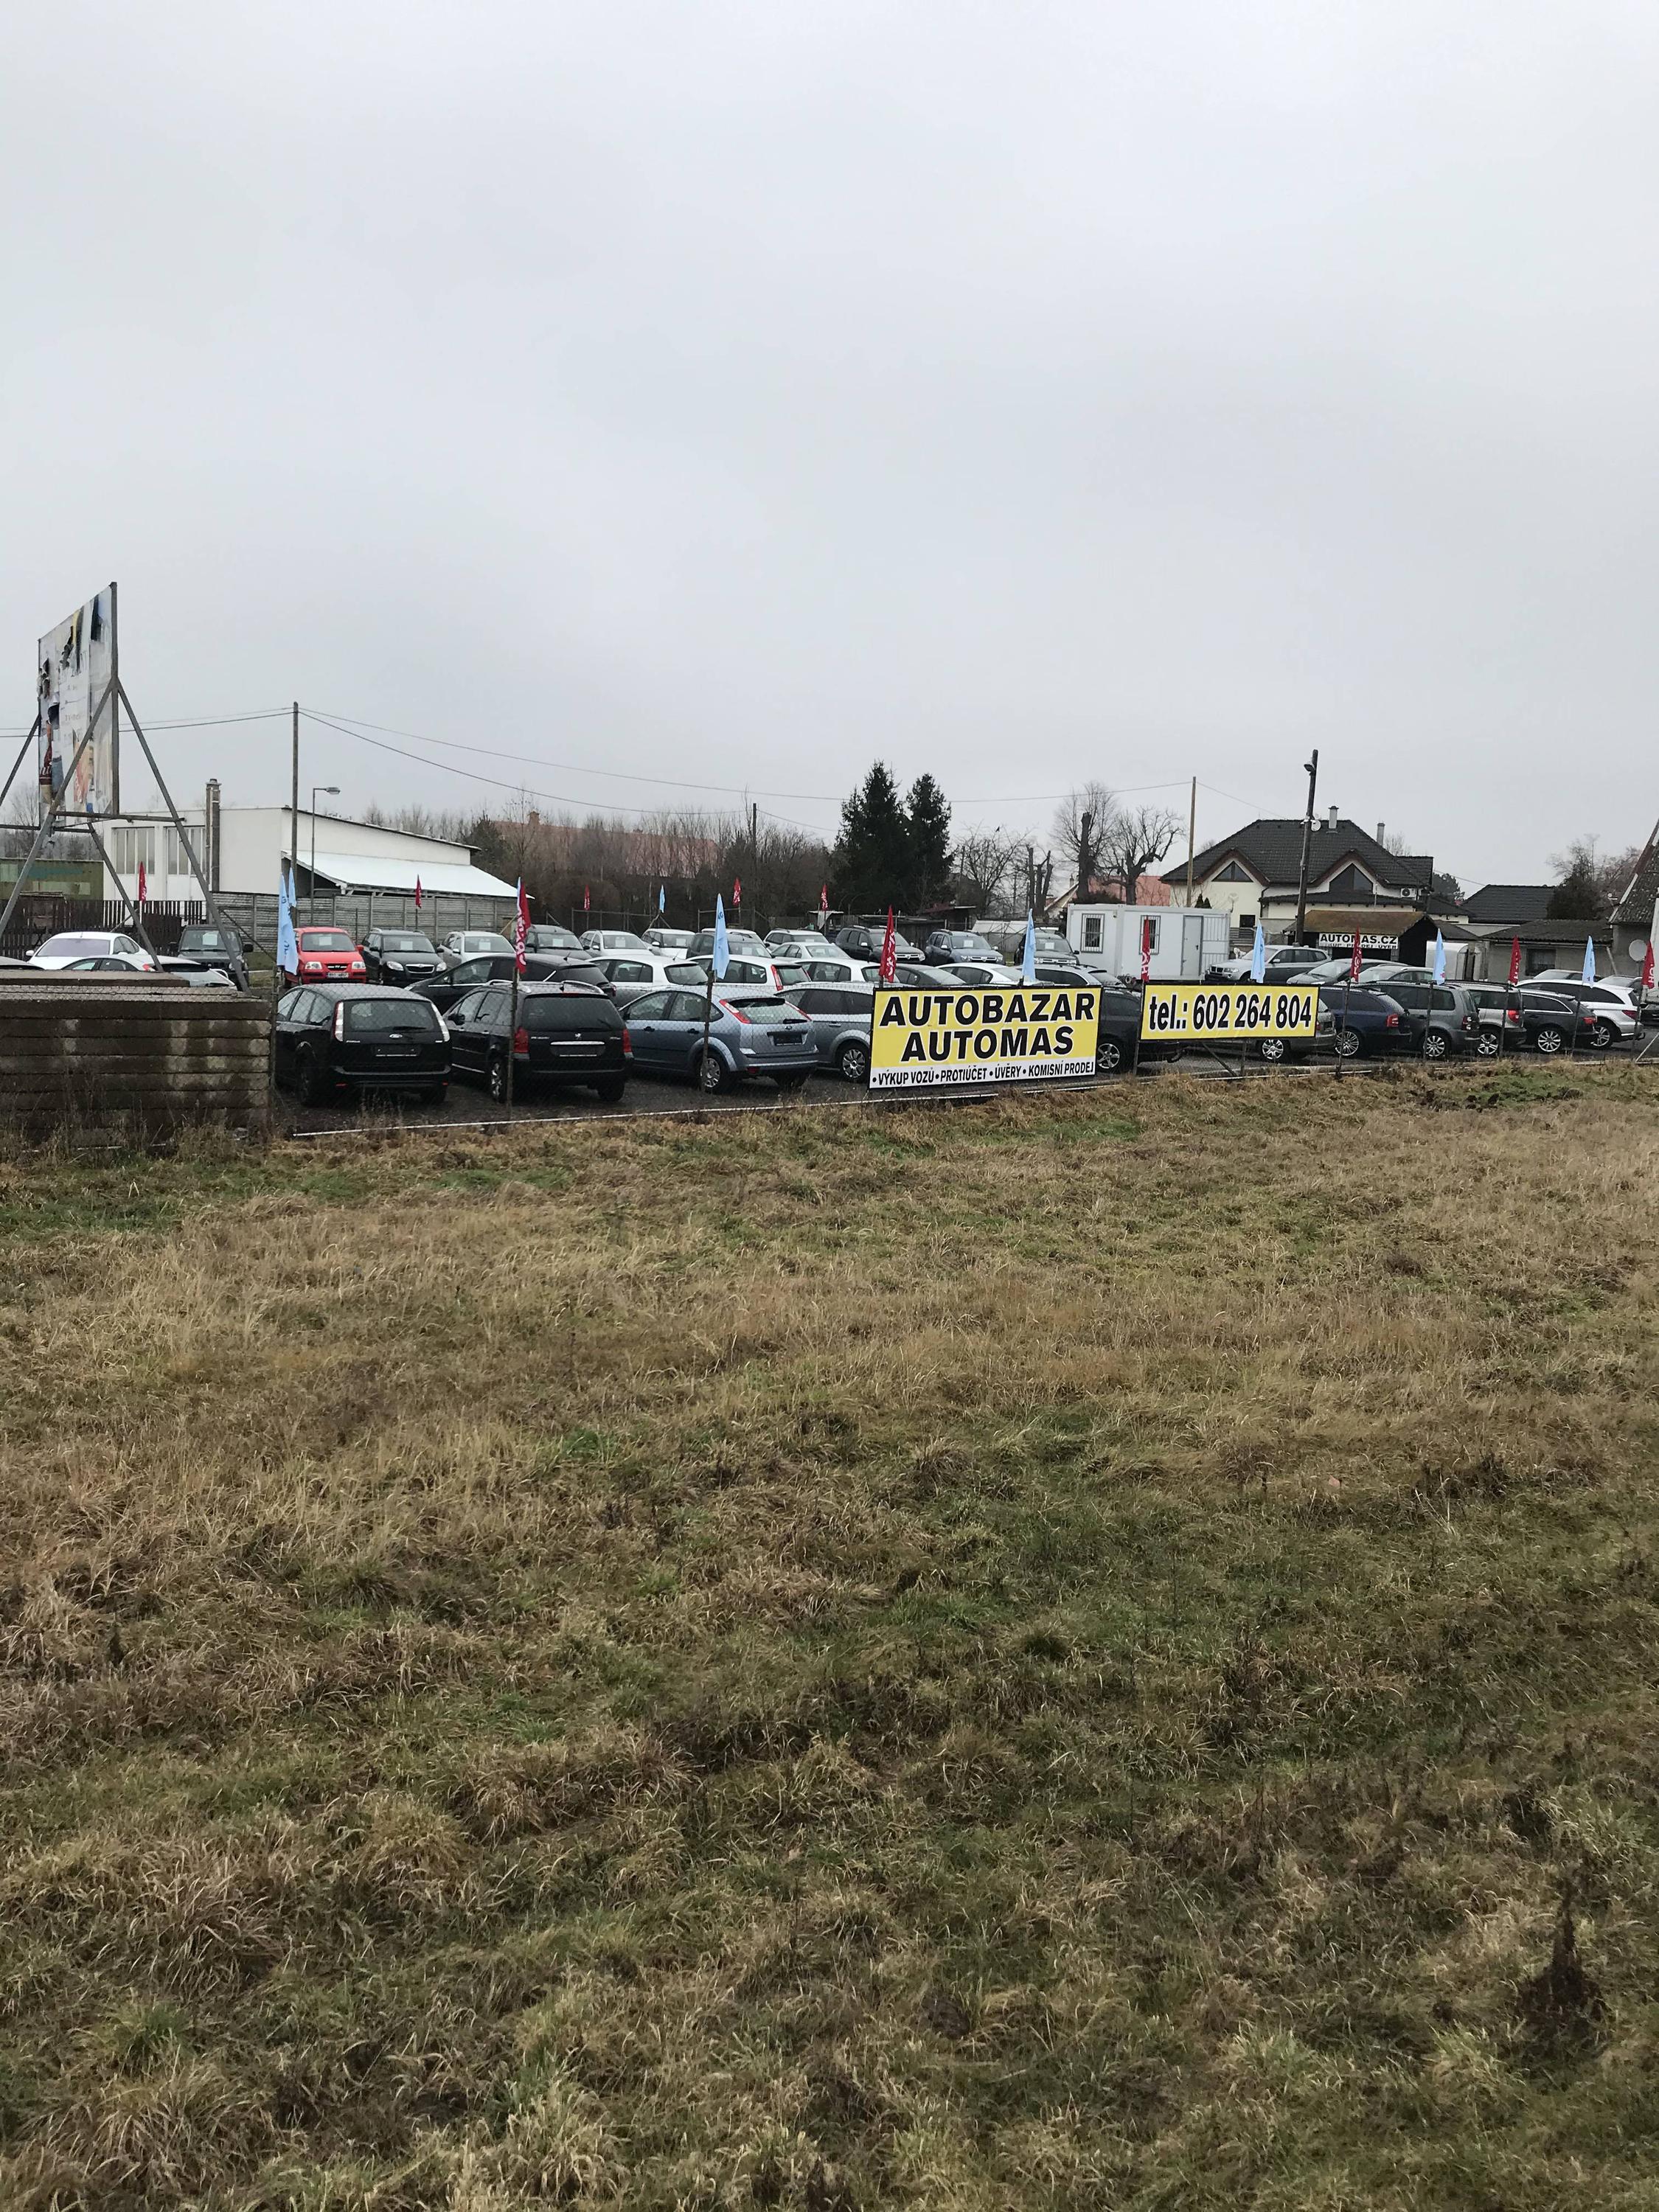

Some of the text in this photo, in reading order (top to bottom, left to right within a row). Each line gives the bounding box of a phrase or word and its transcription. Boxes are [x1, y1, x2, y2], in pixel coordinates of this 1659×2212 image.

[880, 993, 1095, 1026] AUTOBAZAR
[1150, 994, 1311, 1030] tel.: 602 264 804
[901, 1026, 1074, 1062] AUTOMAS
[878, 1069, 909, 1085] VÝKUP
[940, 1065, 987, 1082] PROTIÚČET
[995, 1063, 1021, 1079] ÚVĚRY
[1028, 1060, 1063, 1077] KOMISNÍ
[1064, 1062, 1094, 1074] PRODEJ
